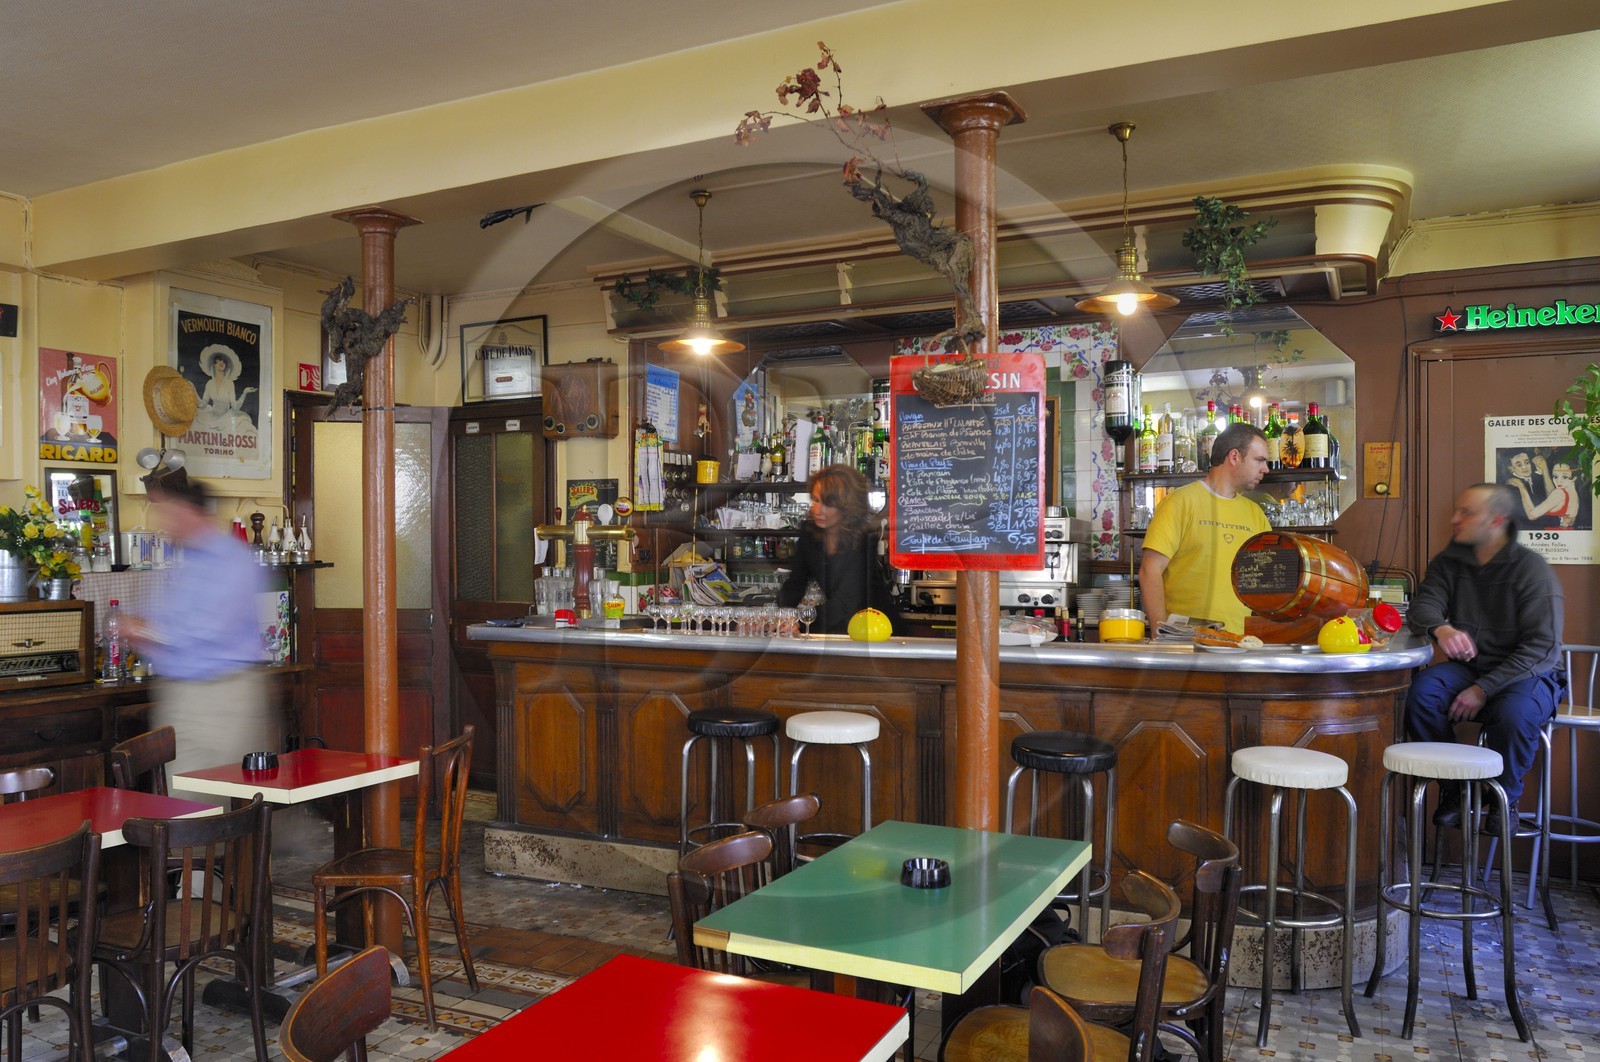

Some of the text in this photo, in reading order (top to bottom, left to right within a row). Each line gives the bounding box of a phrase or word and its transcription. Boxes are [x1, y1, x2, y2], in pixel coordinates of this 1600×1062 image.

[1466, 301, 1600, 331] Heineke
[181, 317, 257, 345] VERMOUTH BIANCO
[508, 344, 533, 358] PARIS
[1488, 418, 1525, 428] GALERIE
[1528, 417, 1545, 427] DES
[40, 443, 117, 463] RICARD
[204, 447, 234, 456] TORINO
[58, 499, 100, 514] SALERS
[1528, 532, 1559, 540] 1930
